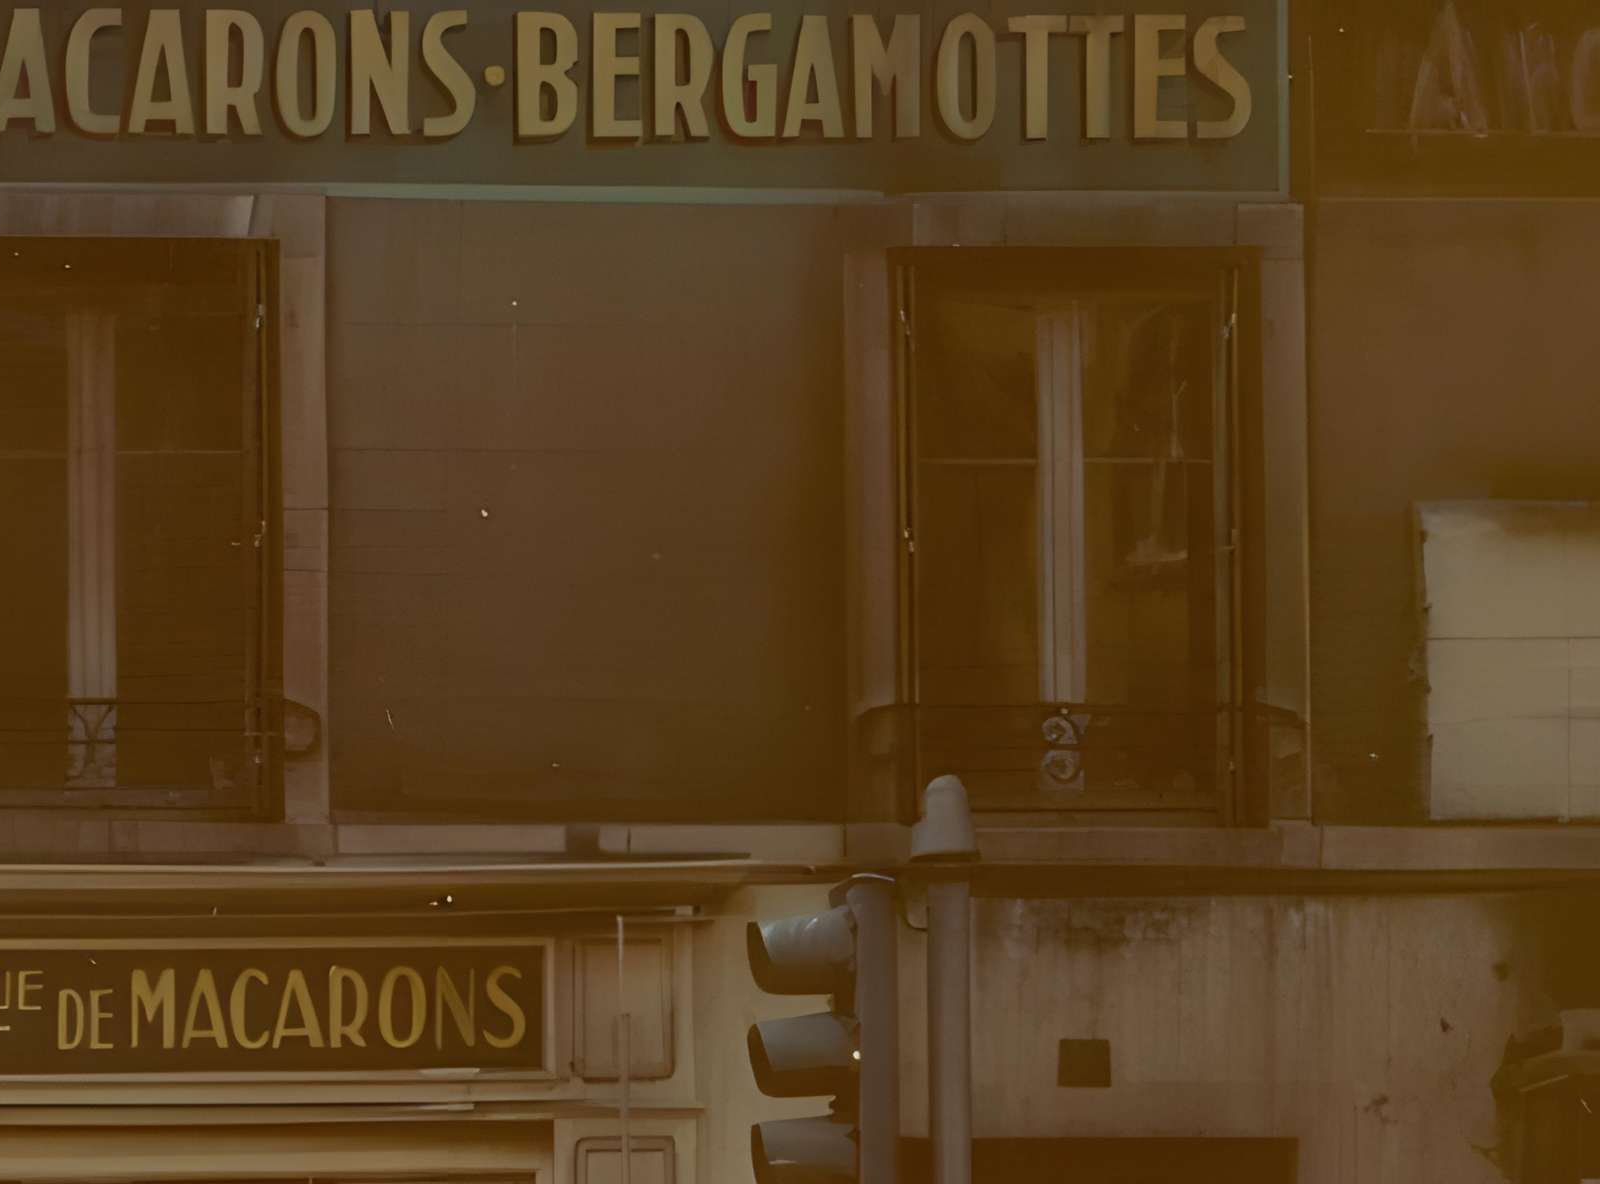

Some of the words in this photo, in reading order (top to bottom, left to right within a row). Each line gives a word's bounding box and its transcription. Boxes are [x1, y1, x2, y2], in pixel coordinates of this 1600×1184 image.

[515, 10, 1250, 142] BERGAMOTTES
[58, 988, 113, 1050] DE
[131, 965, 526, 1050] MACARONS
